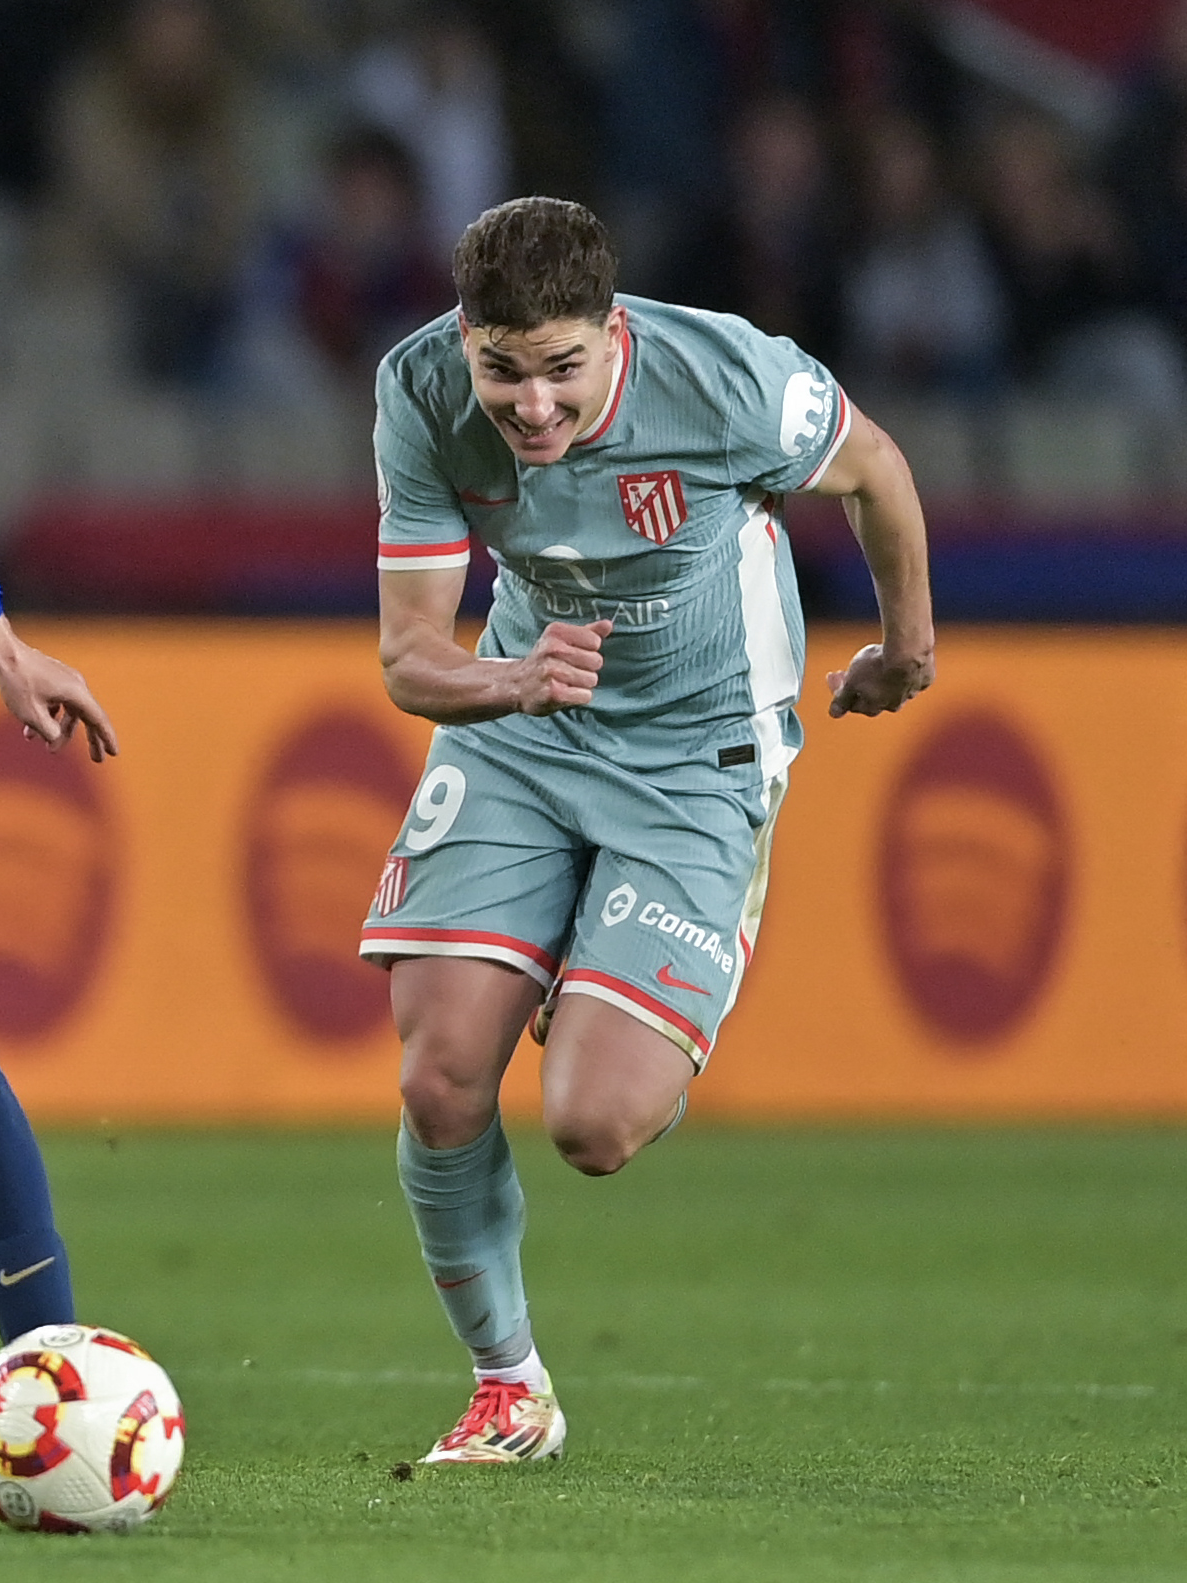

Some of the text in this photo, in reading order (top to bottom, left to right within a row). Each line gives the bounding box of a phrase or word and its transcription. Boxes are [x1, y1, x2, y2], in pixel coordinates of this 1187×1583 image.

[611, 598, 671, 626] AIR
[404, 763, 467, 851] 9
[638, 901, 734, 974] ComAve
